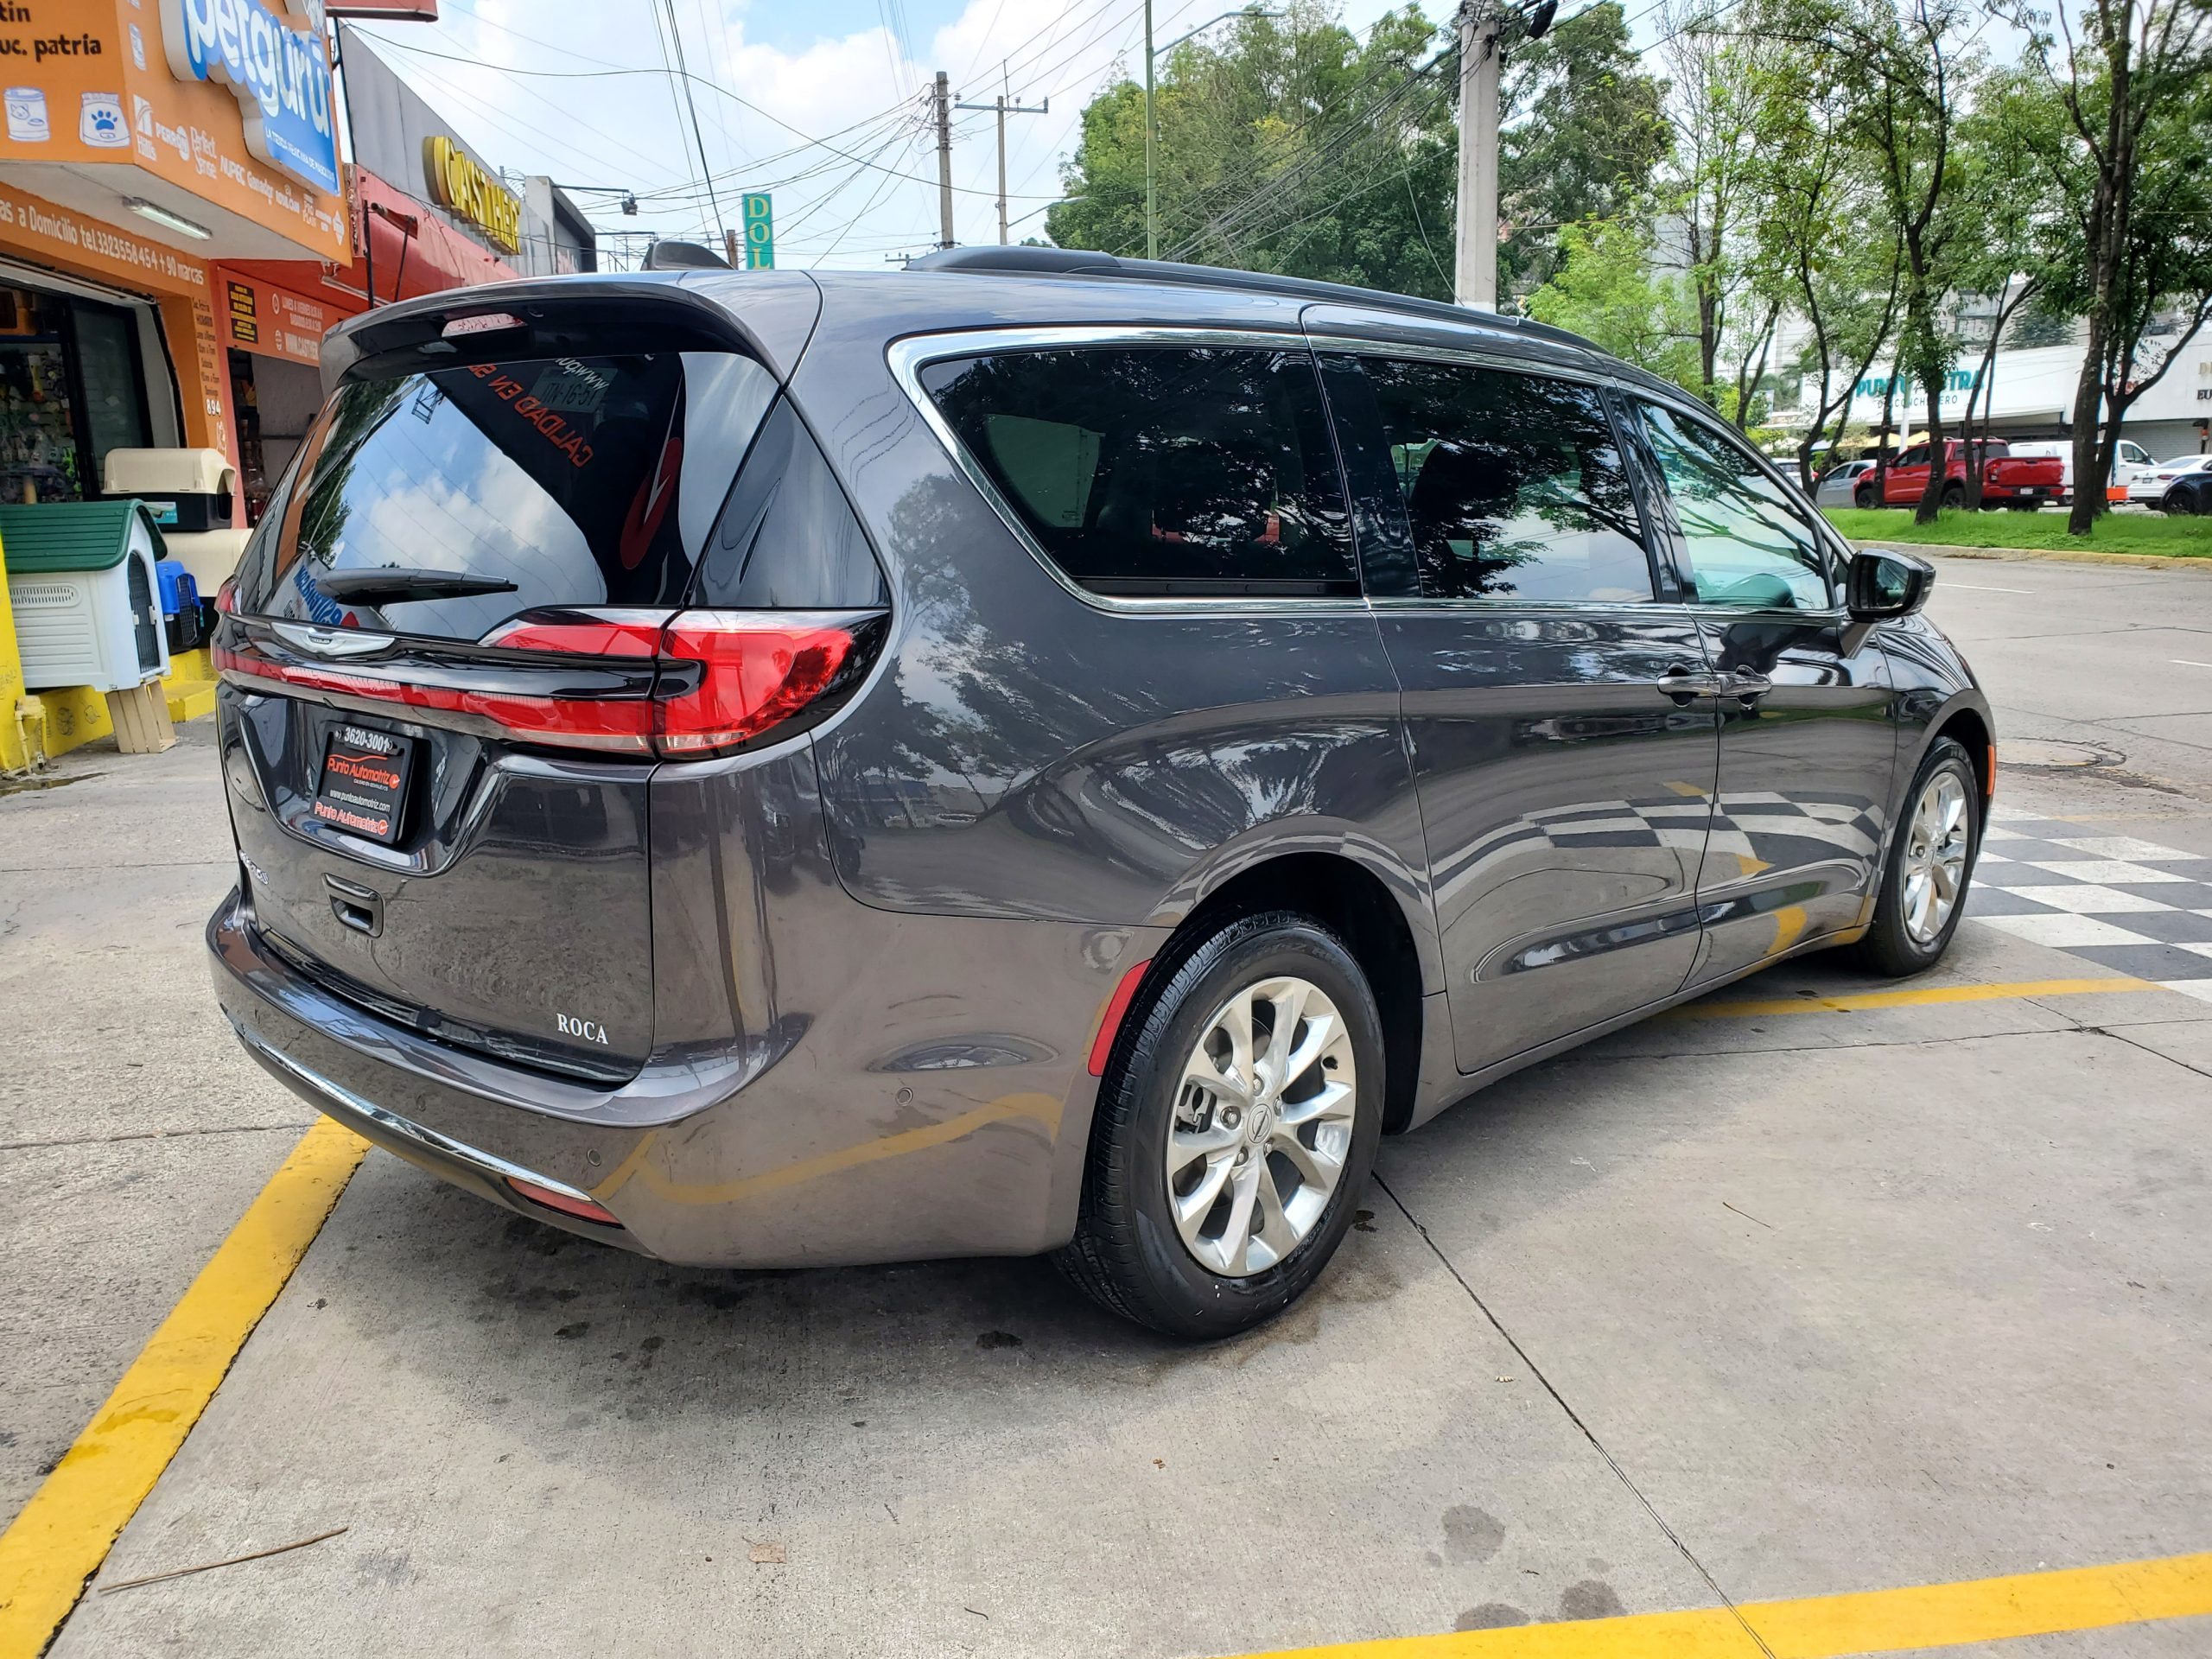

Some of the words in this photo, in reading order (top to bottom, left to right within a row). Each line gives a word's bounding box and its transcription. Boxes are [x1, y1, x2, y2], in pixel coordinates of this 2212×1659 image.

[35, 33, 102, 62] patria
[18, 207, 27, 227] a
[29, 206, 78, 245] Domicilio
[206, 398, 221, 416] 894
[344, 727, 389, 753] 3620-3001
[327, 758, 349, 774] Punto
[349, 762, 390, 785] Automotriz
[329, 789, 391, 812] www.puntoautomotriz.com
[314, 801, 338, 821] Punto
[336, 808, 378, 834] Automotriz
[556, 1013, 608, 1045] ROCA
